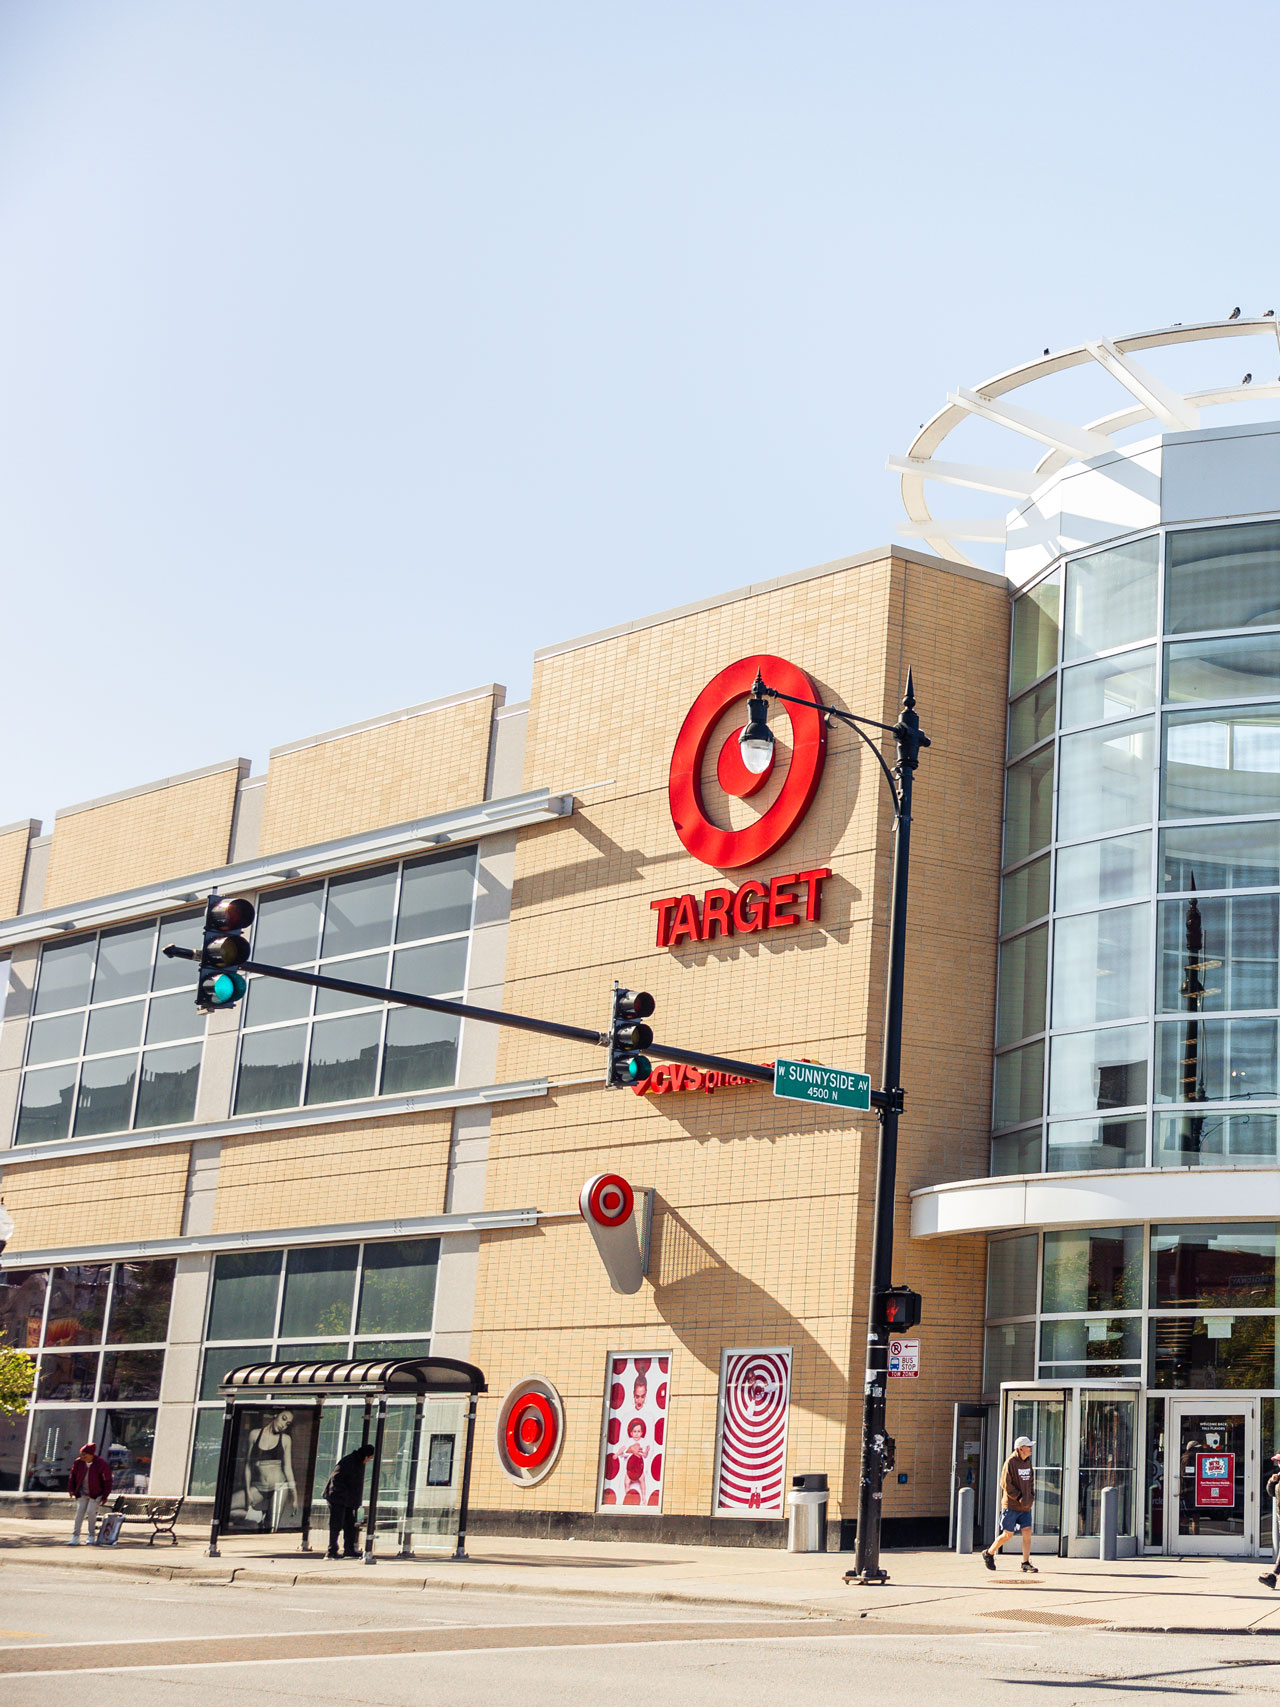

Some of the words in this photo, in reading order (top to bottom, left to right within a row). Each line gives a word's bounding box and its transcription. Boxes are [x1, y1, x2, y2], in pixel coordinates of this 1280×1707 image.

[650, 868, 832, 948] TARGET
[651, 1063, 703, 1095] CVS
[789, 1065, 855, 1091] SUNNYSIDE
[858, 1080, 868, 1091] AV
[807, 1087, 829, 1099] 4500
[832, 1090, 838, 1101] N
